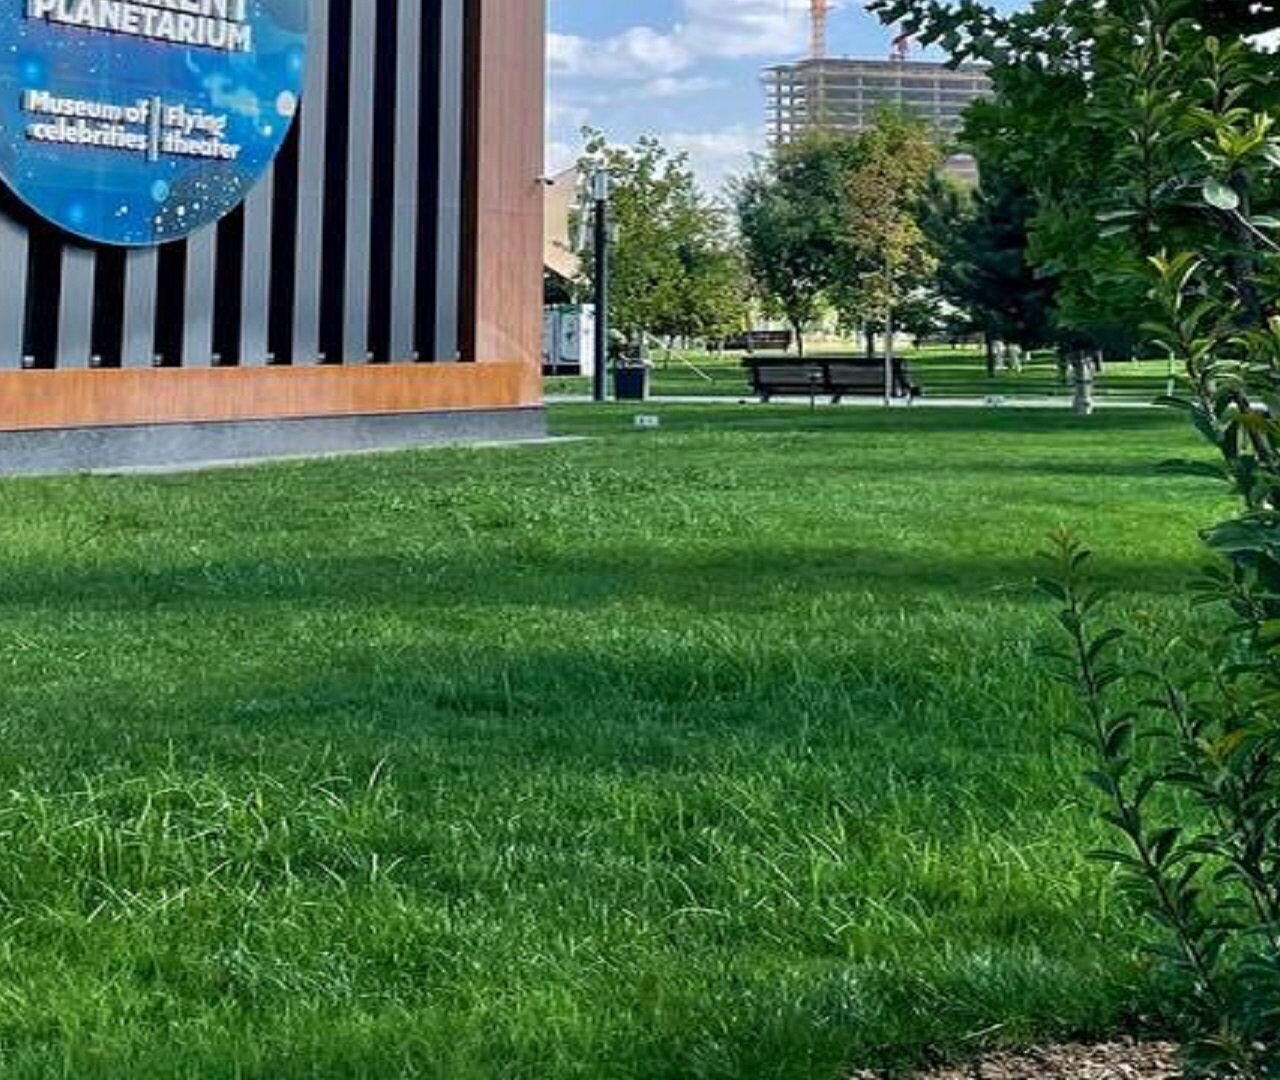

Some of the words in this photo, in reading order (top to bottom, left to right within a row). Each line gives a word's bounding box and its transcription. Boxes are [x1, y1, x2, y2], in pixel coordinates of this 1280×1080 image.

[24, 89, 122, 121] Museum
[126, 99, 150, 124] of
[163, 104, 228, 137] Flying
[27, 117, 147, 150] celebrities
[163, 131, 241, 159] theater
